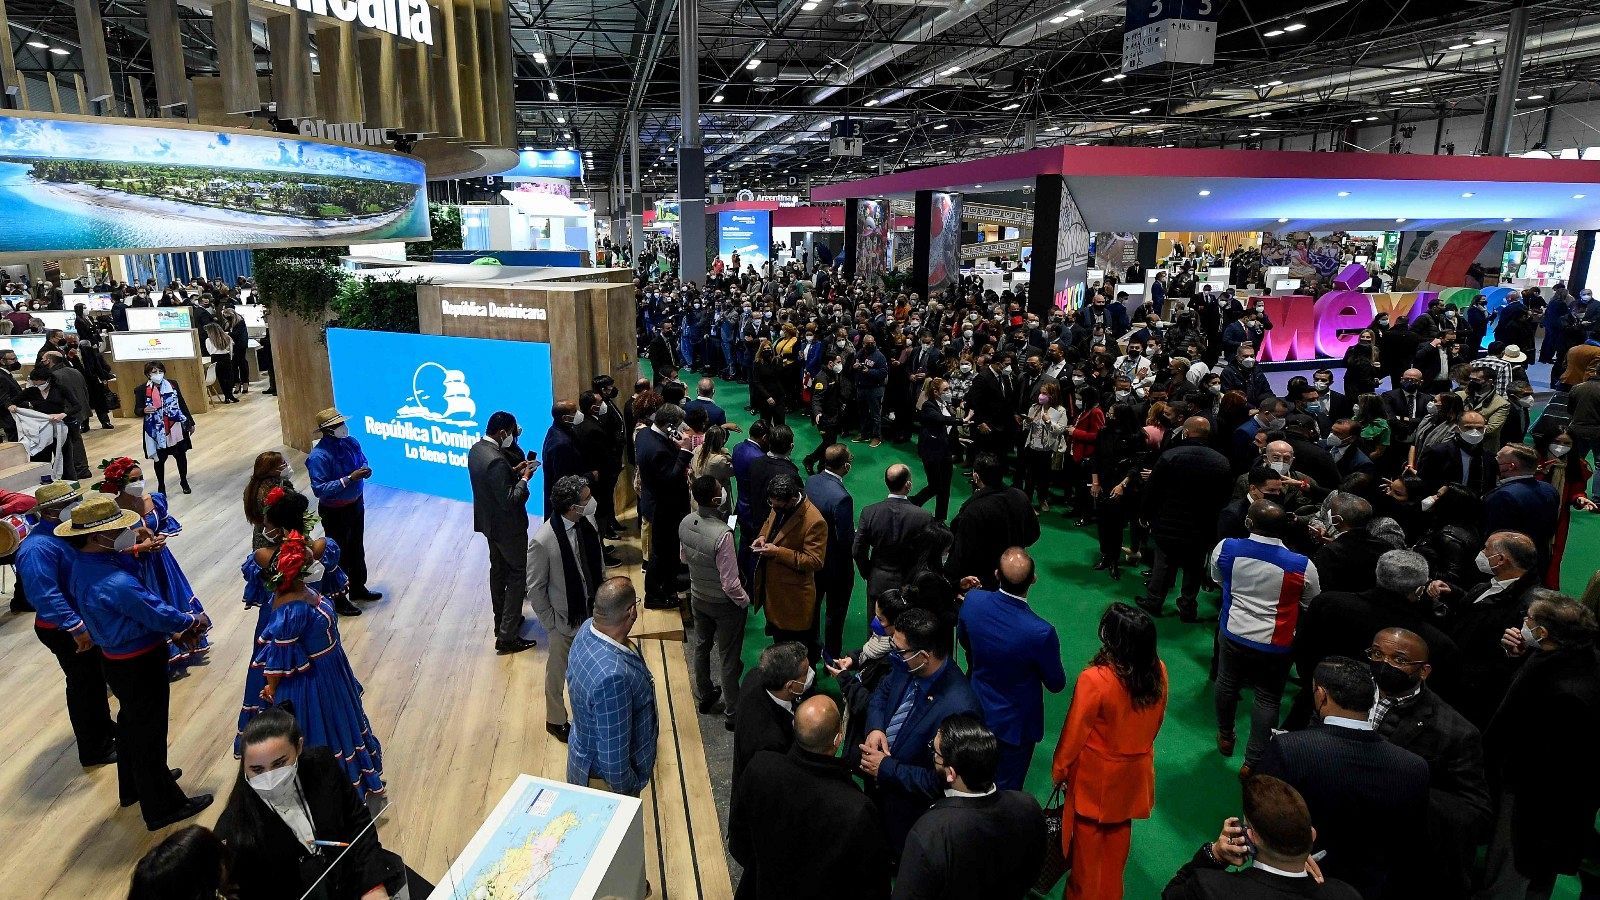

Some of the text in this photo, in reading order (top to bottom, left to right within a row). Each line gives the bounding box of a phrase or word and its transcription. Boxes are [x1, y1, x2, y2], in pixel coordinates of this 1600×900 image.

[852, 123, 861, 136] 3
[486, 175, 495, 185] B
[788, 176, 797, 185] D
[441, 299, 547, 321] República Dominicana
[364, 415, 430, 443] República
[405, 443, 418, 459] Lo
[419, 445, 447, 464] tiene
